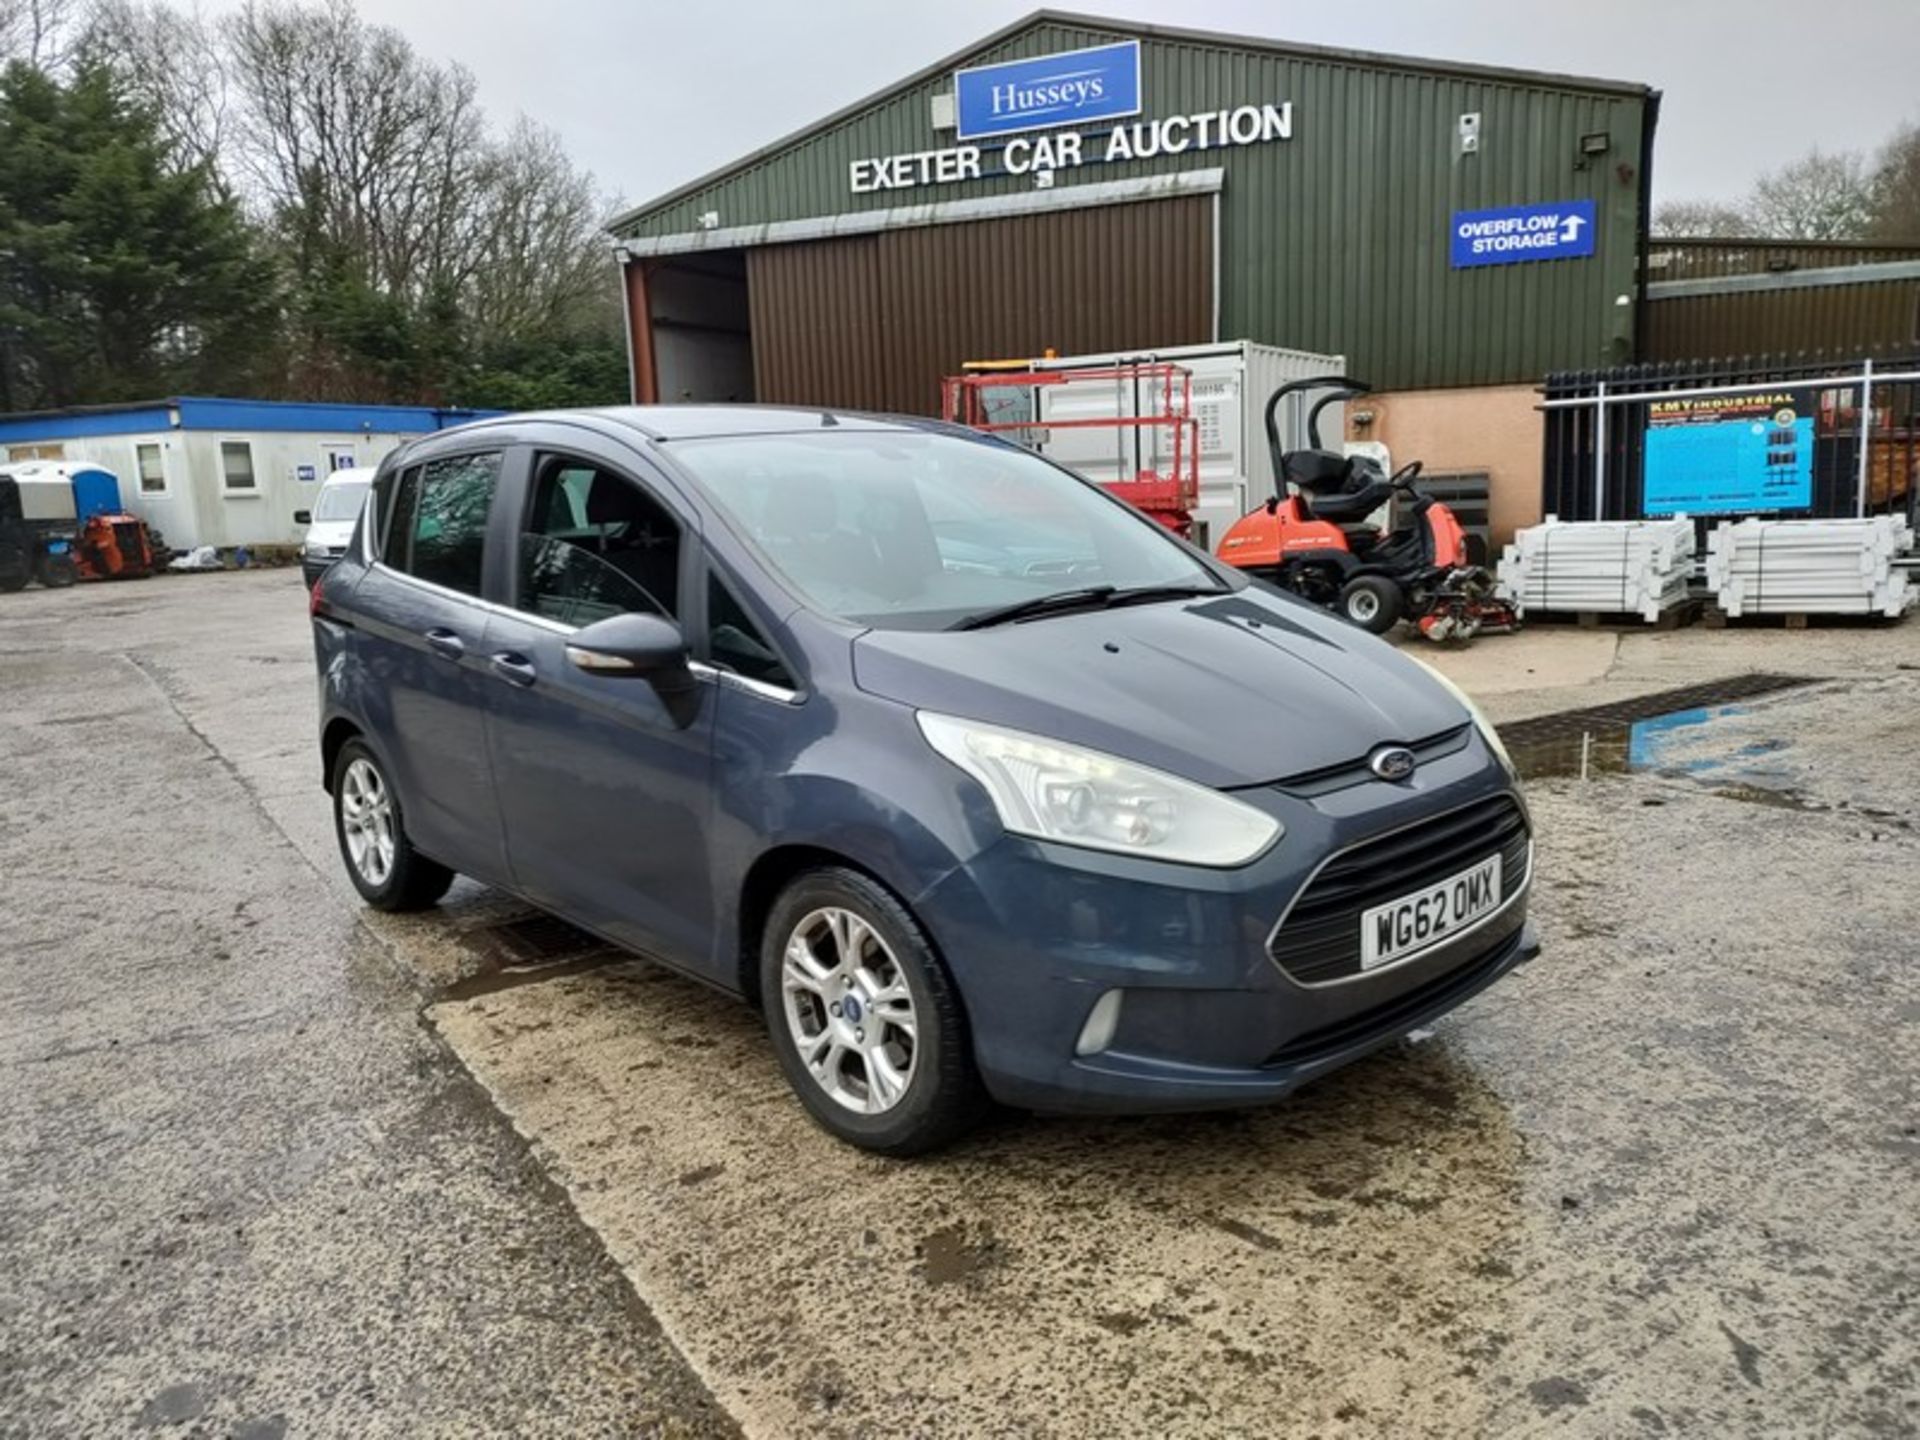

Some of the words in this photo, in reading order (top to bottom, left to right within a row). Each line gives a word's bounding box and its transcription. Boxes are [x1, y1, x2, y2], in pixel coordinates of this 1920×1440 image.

[991, 77, 1103, 114] Husseys
[848, 154, 980, 193] EXETER
[1003, 132, 1082, 174] CAR
[1105, 102, 1293, 162] AUCTION
[1458, 215, 1559, 238] OVERFLOW
[1472, 231, 1558, 253] STORAGE
[1377, 891, 1447, 956] WG62
[1453, 865, 1494, 921] OMX
